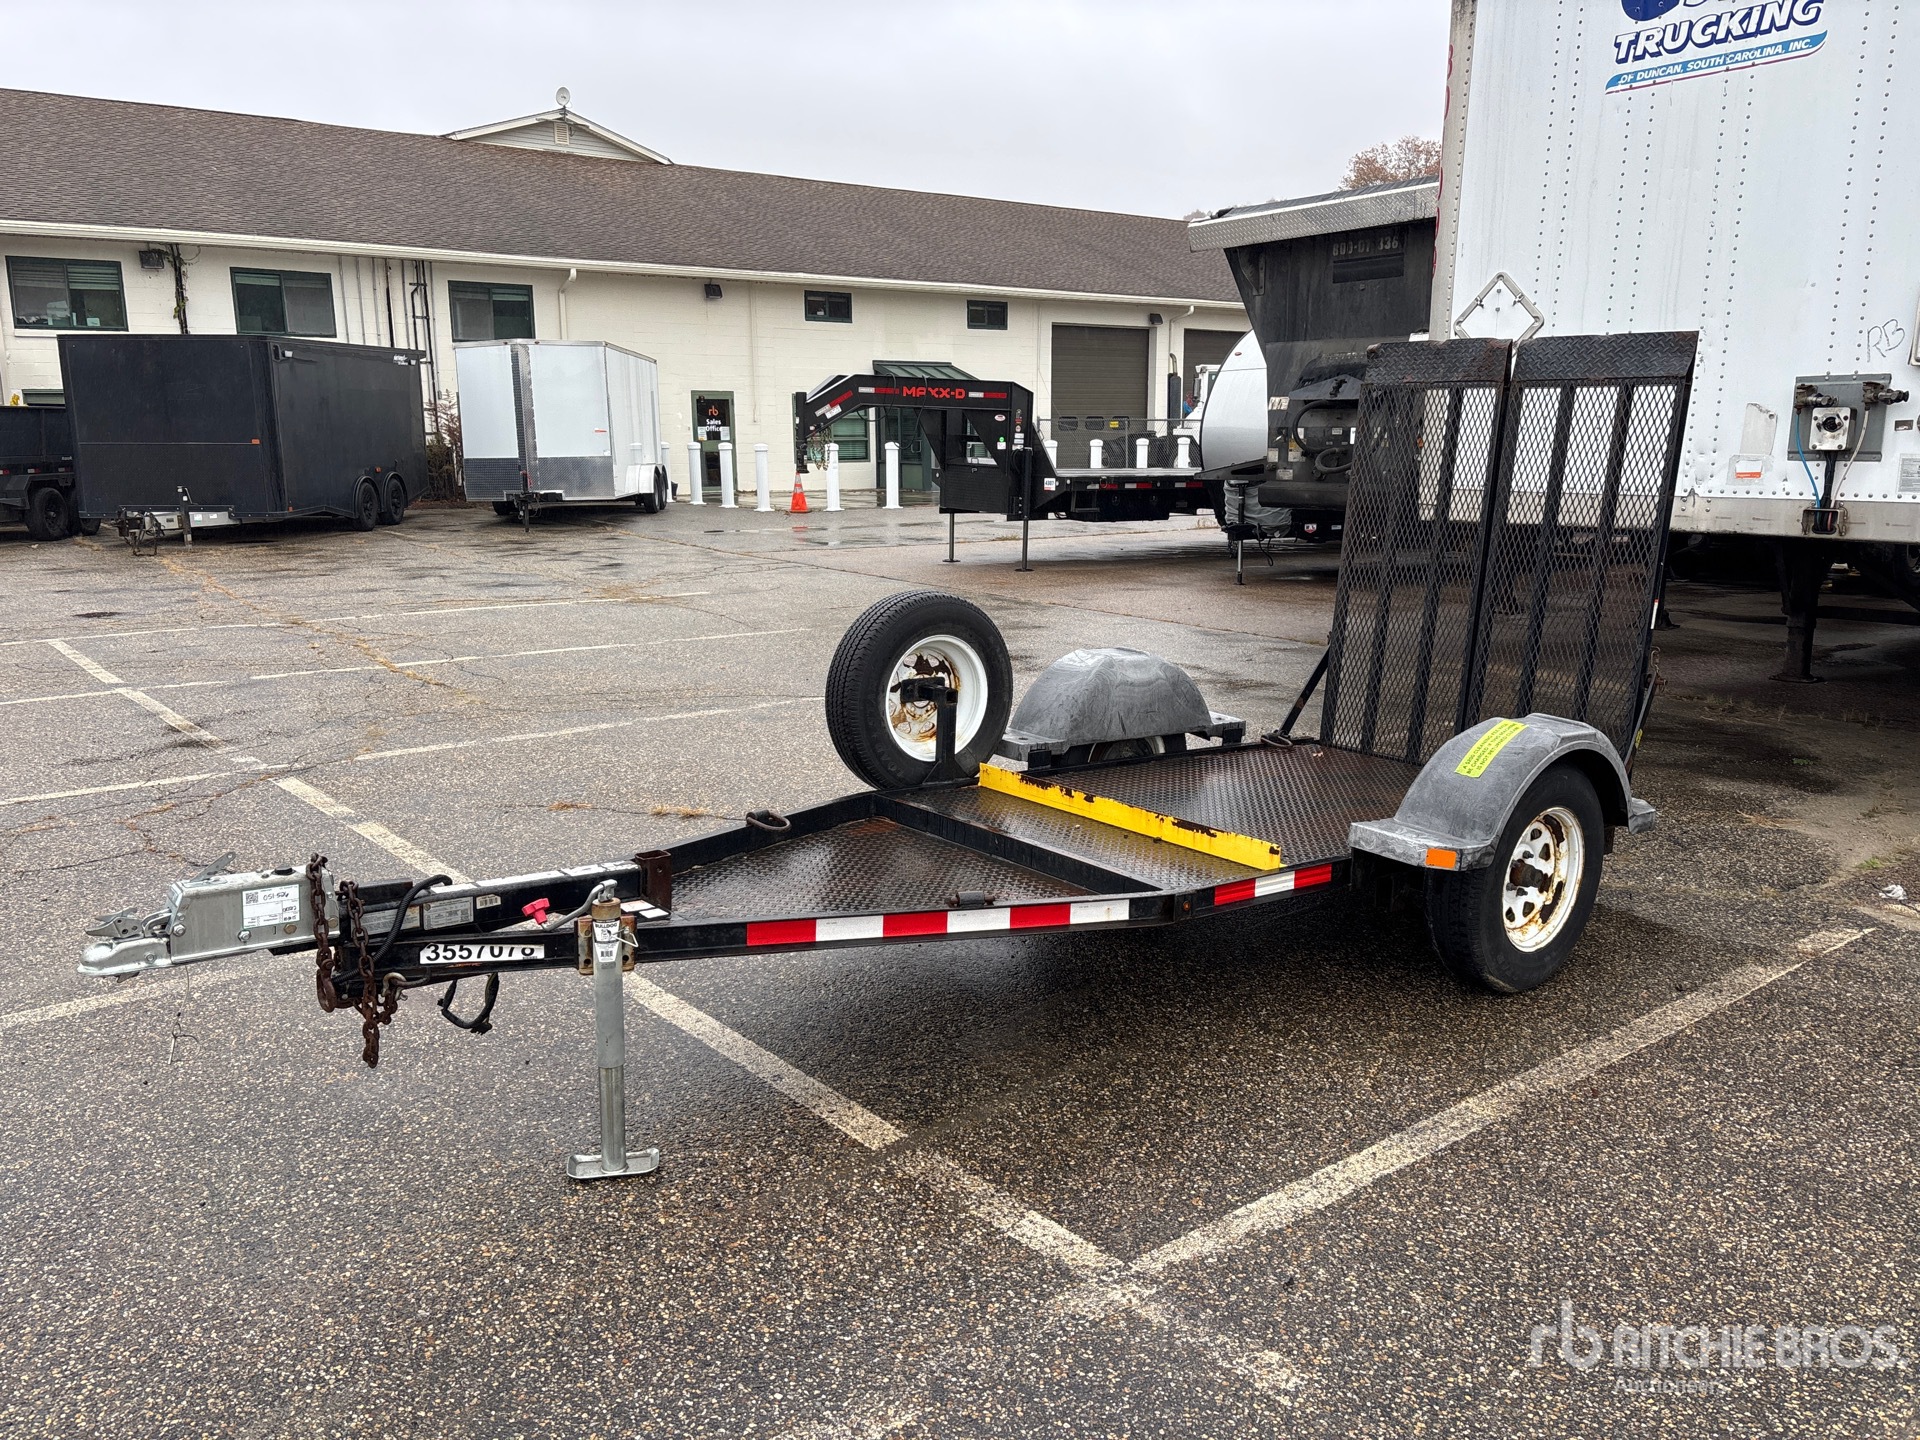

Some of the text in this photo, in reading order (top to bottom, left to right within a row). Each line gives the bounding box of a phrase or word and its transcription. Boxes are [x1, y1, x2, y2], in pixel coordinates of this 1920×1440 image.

[1614, 0, 1825, 64] TRUCKING
[1619, 39, 1813, 85] OF DUNCAN, SOUTH CAROLINA, INC.
[1866, 318, 1905, 363] RB
[708, 405, 719, 416] rb
[902, 386, 966, 399] MAXX-D
